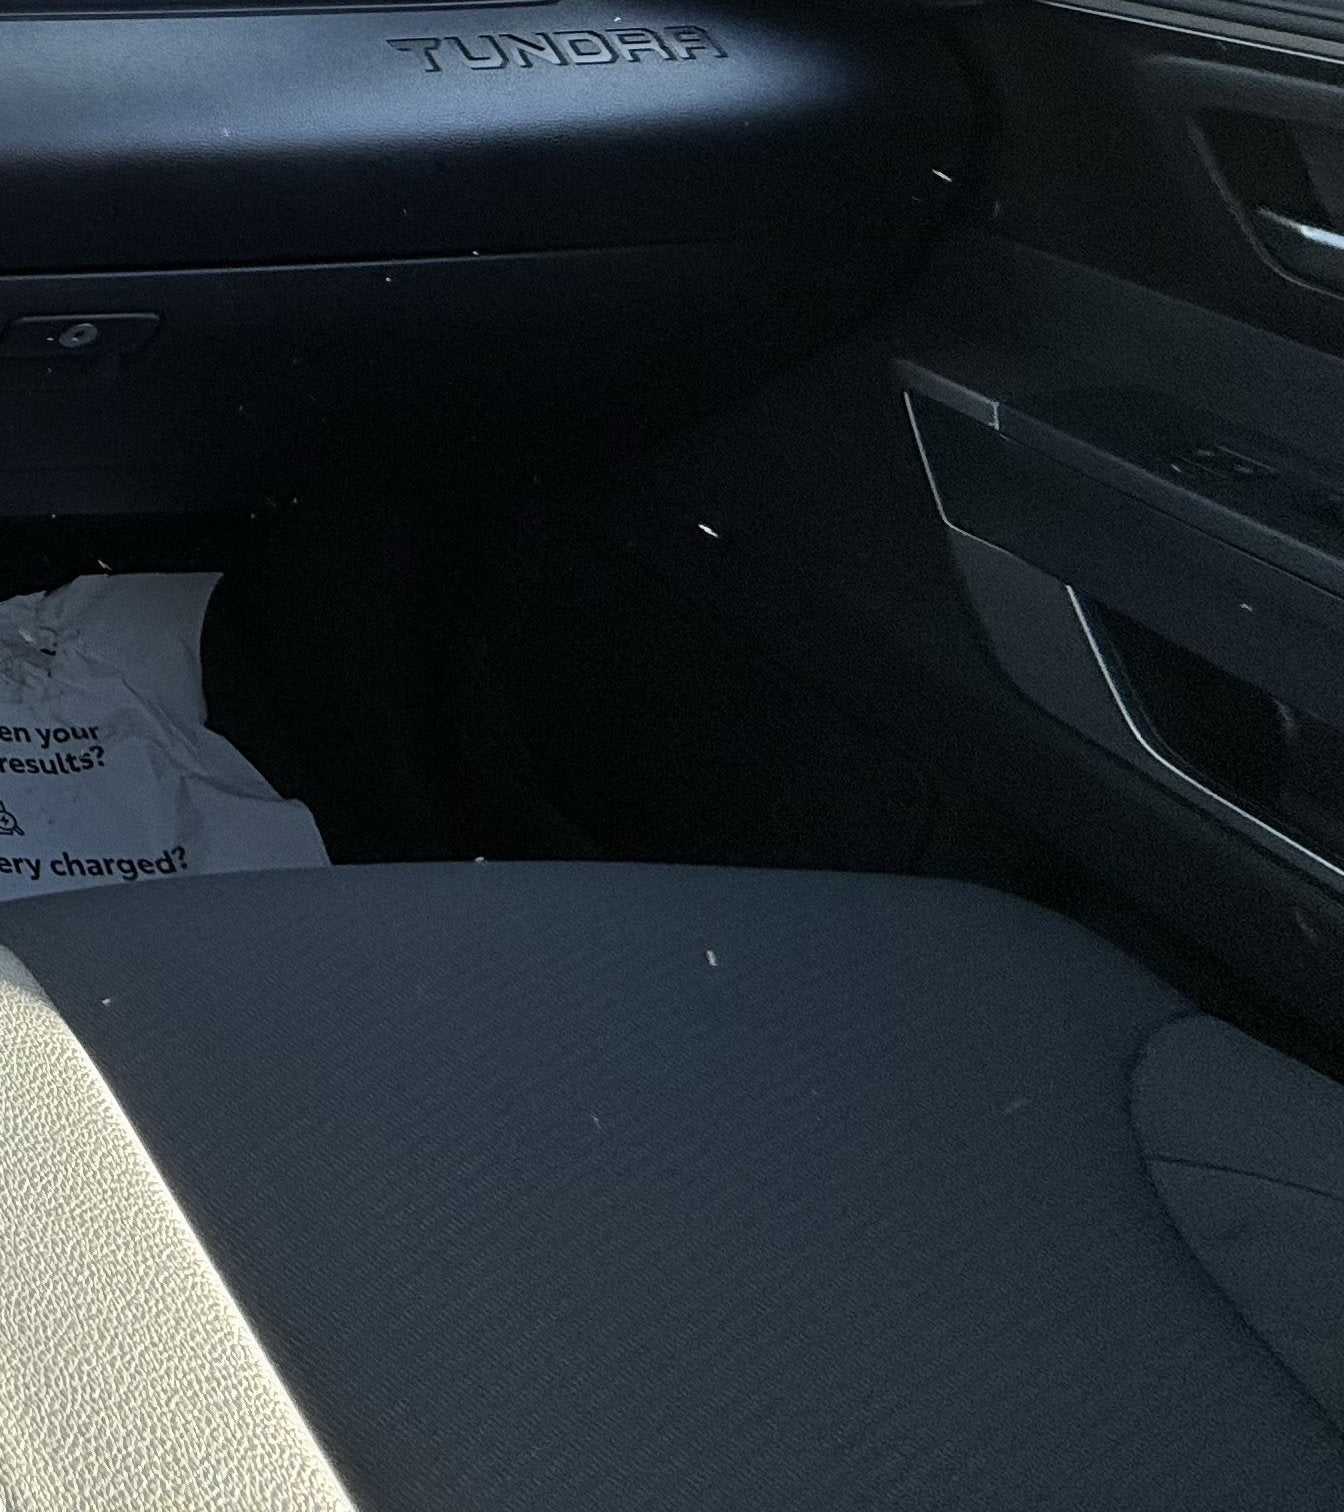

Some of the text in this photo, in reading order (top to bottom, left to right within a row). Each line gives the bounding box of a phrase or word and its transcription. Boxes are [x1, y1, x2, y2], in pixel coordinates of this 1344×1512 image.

[386, 25, 728, 73] TUNDRA
[34, 725, 99, 749] your
[50, 845, 189, 882] charged?
